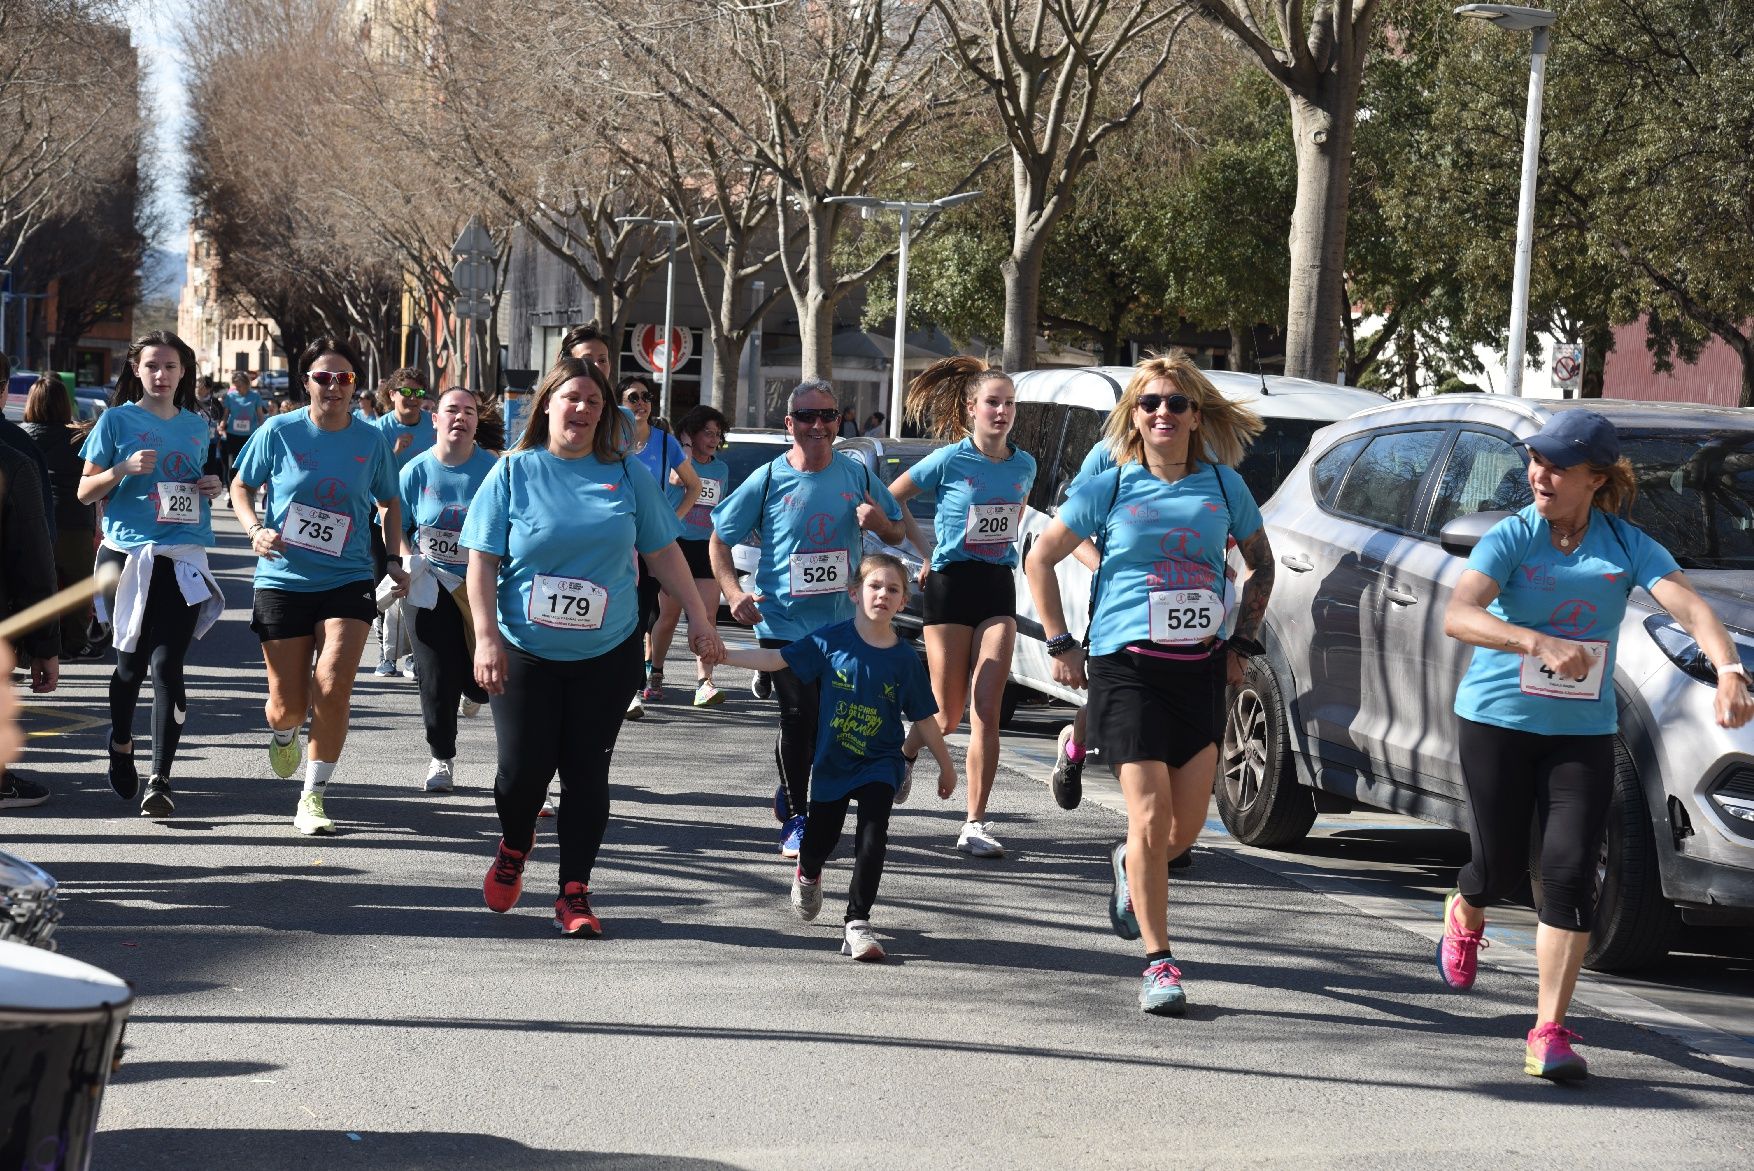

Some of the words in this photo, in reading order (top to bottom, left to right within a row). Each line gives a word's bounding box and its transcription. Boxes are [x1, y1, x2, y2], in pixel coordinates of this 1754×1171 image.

[700, 487, 715, 498] 55
[169, 496, 192, 512] 282
[299, 519, 334, 542] 735
[979, 516, 1009, 533] 208
[429, 537, 458, 555] 204
[803, 565, 837, 583] 526
[548, 593, 590, 617] 179
[1167, 607, 1211, 630] 525
